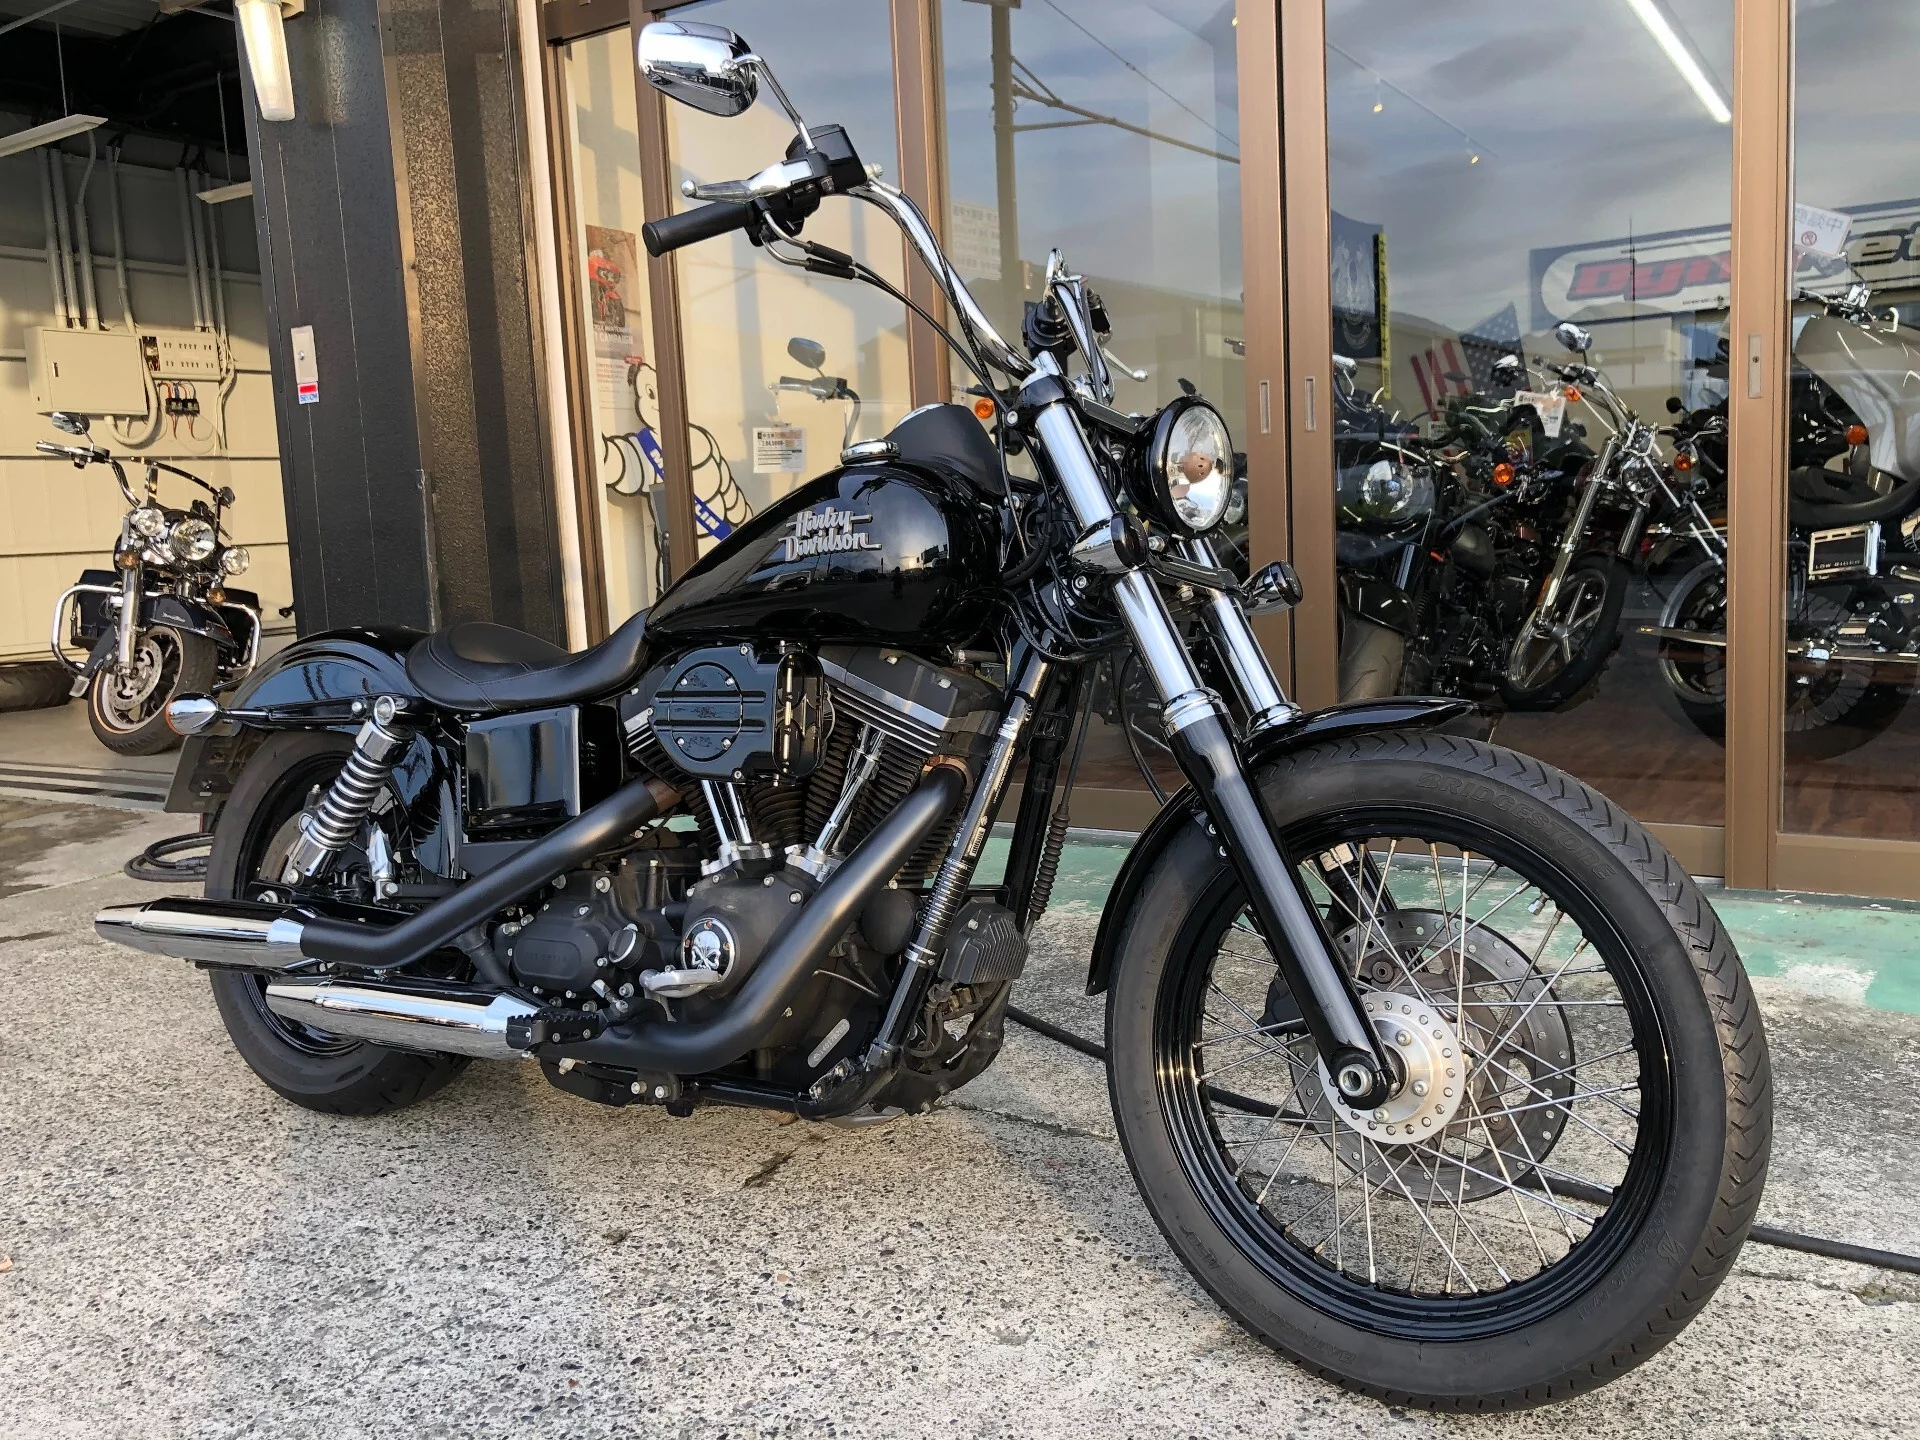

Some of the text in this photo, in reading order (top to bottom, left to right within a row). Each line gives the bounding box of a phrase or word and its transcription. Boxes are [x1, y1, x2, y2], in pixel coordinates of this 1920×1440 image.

[786, 507, 873, 537] Harley
[778, 528, 882, 561] Davidson
[1416, 771, 1619, 881] BRIDGESTONE
